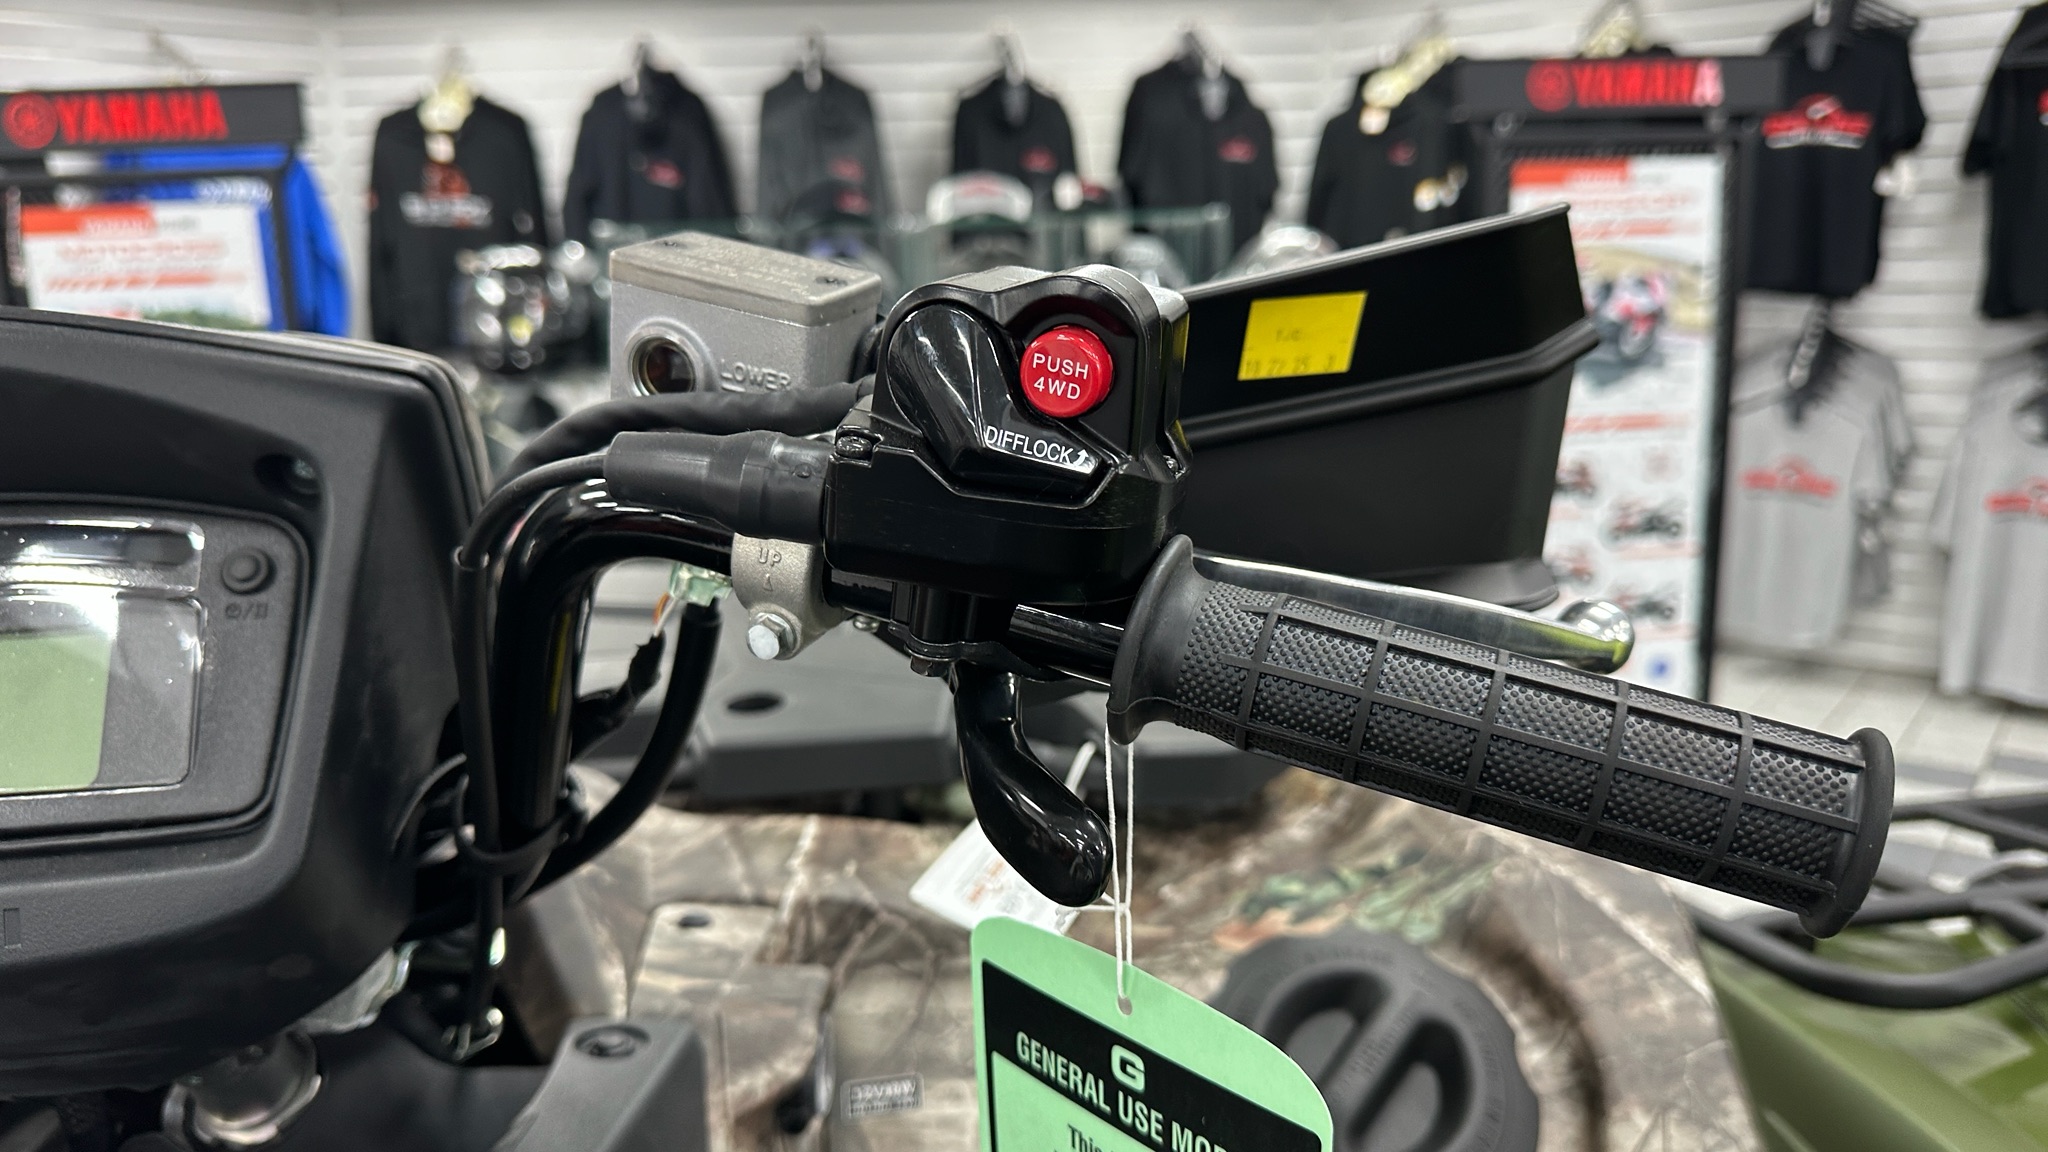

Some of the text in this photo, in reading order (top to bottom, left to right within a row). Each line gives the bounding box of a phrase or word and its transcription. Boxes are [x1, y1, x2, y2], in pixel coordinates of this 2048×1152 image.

[1571, 60, 1725, 107] YAMAHA
[56, 89, 230, 145] YAMAHA
[720, 358, 792, 390] LOWER
[1032, 352, 1089, 380] PUSH
[1033, 376, 1081, 400] 4WD
[985, 425, 1074, 465] DIFFLOCK
[759, 547, 782, 567] UP
[1015, 1030, 1112, 1115] GENERAL
[1117, 1090, 1164, 1146] USE
[1110, 1043, 1146, 1094] G
